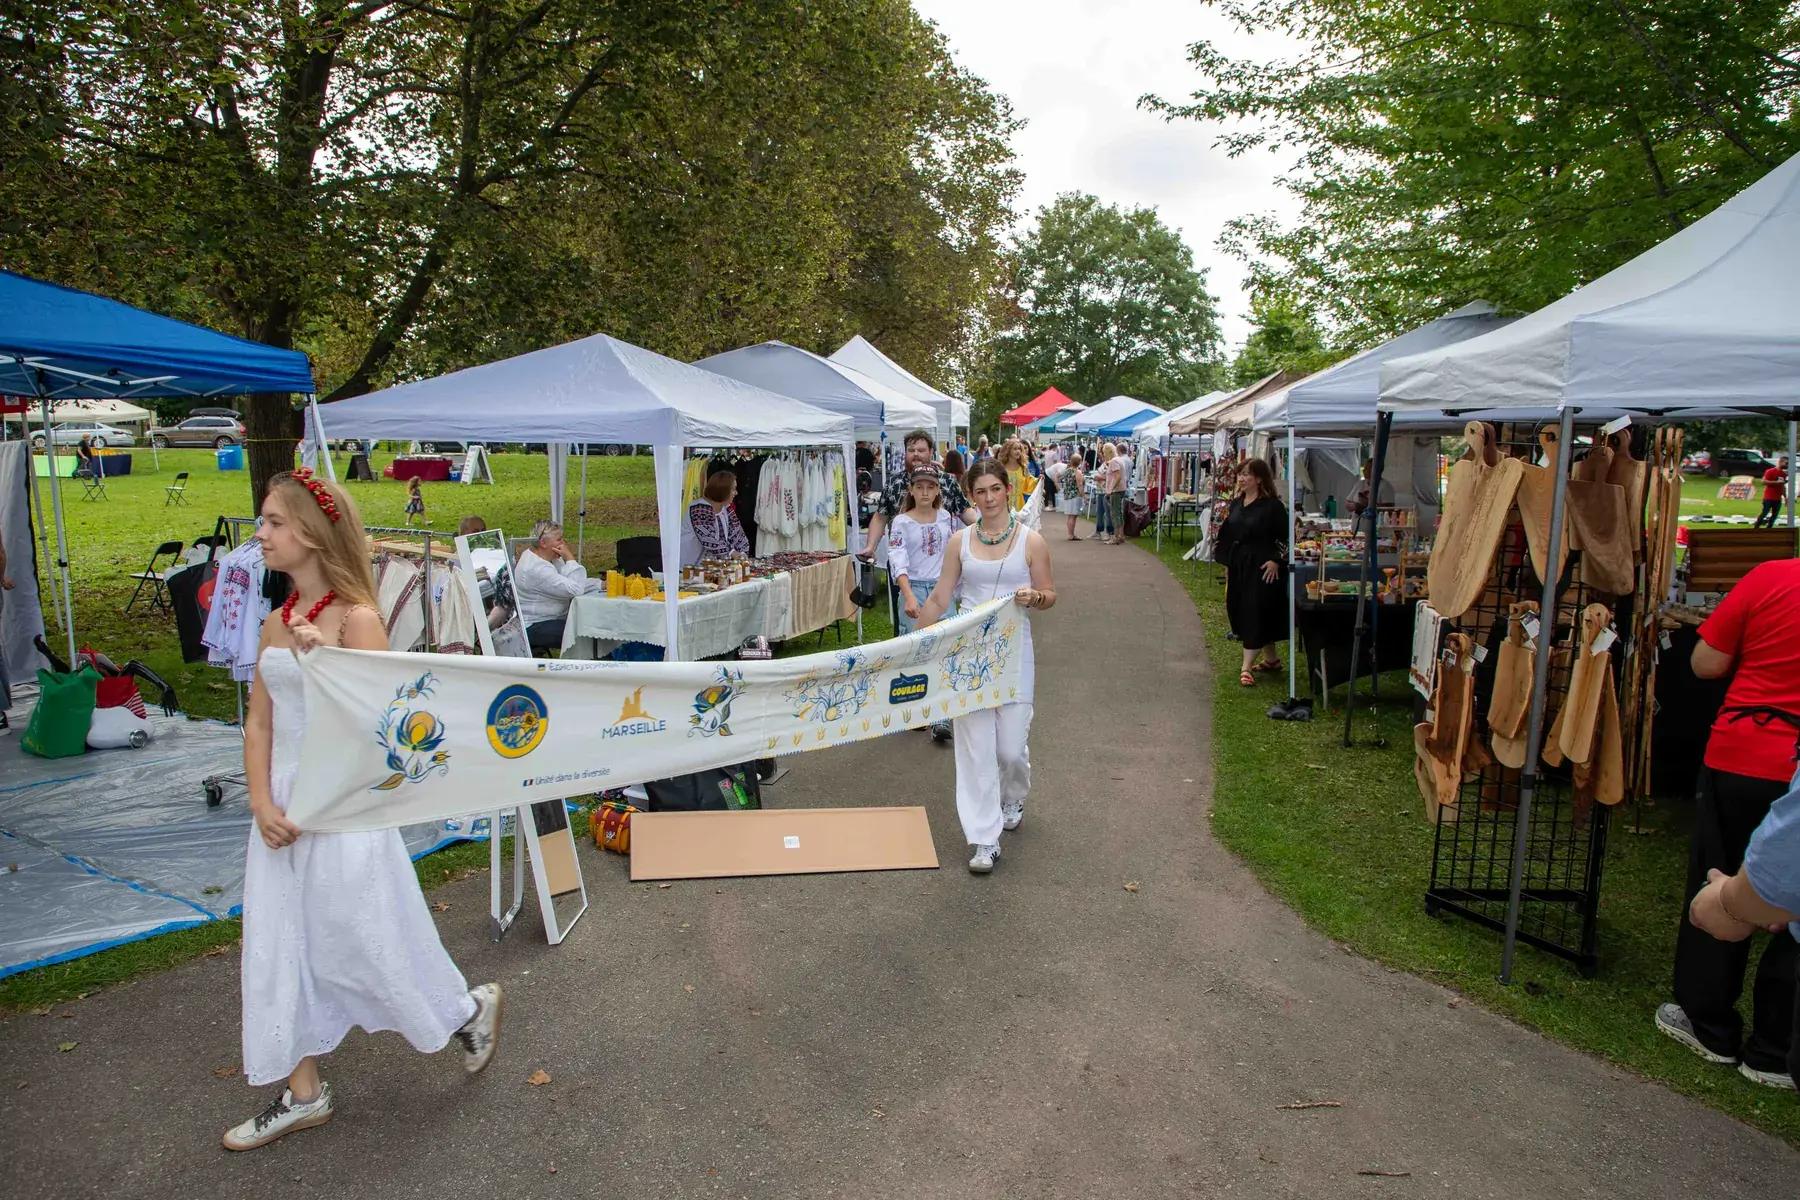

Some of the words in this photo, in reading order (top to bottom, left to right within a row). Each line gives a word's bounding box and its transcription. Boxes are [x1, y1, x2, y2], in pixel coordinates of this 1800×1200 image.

[891, 684, 926, 697] COURAGE
[602, 720, 666, 739] MARSEILLE
[555, 773, 572, 782] dans
[573, 771, 580, 780] la
